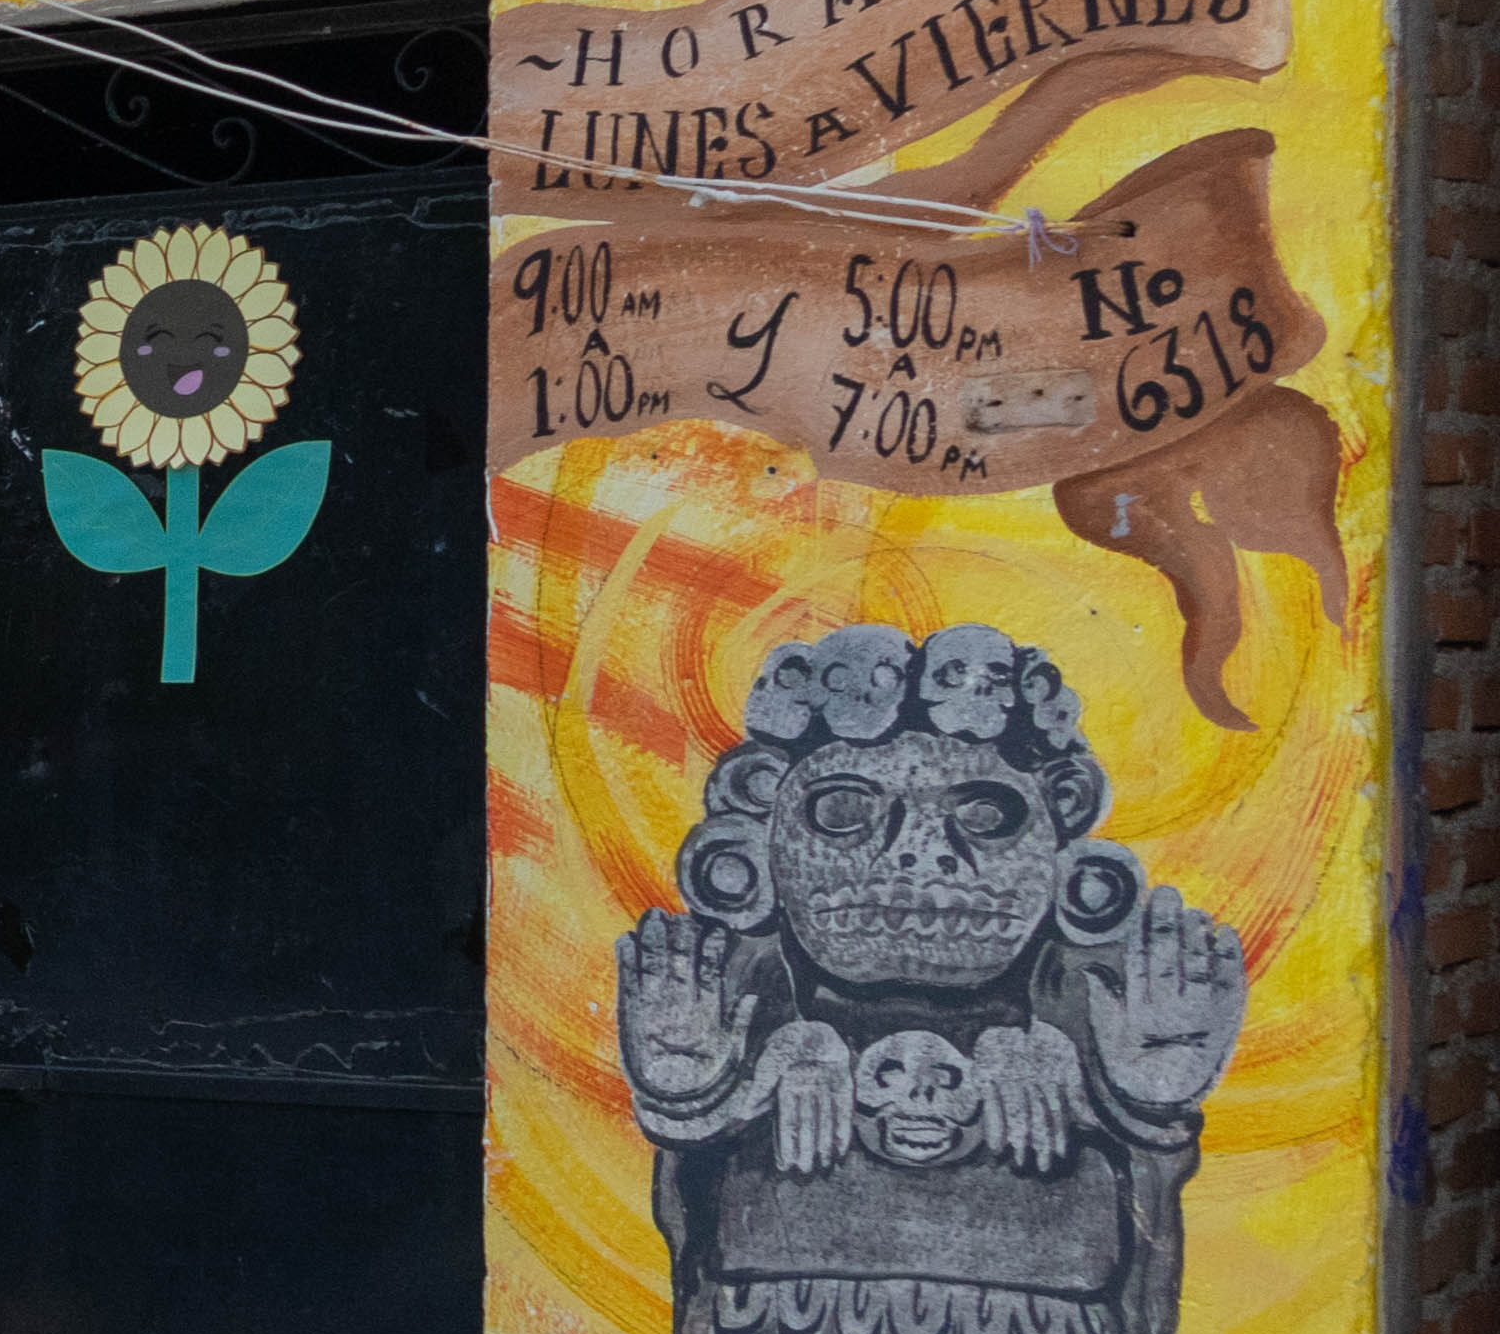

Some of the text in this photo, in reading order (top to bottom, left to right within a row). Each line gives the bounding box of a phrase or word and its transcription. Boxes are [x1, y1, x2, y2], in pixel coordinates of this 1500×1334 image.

[531, 103, 783, 193] LUNES
[513, 240, 662, 336] 9:00 AM
[843, 255, 1003, 361] 5:00 PM
[581, 331, 611, 357] A
[887, 354, 919, 379] A
[527, 354, 670, 439] 1:00 PM
[828, 375, 987, 481] 7:00 PM
